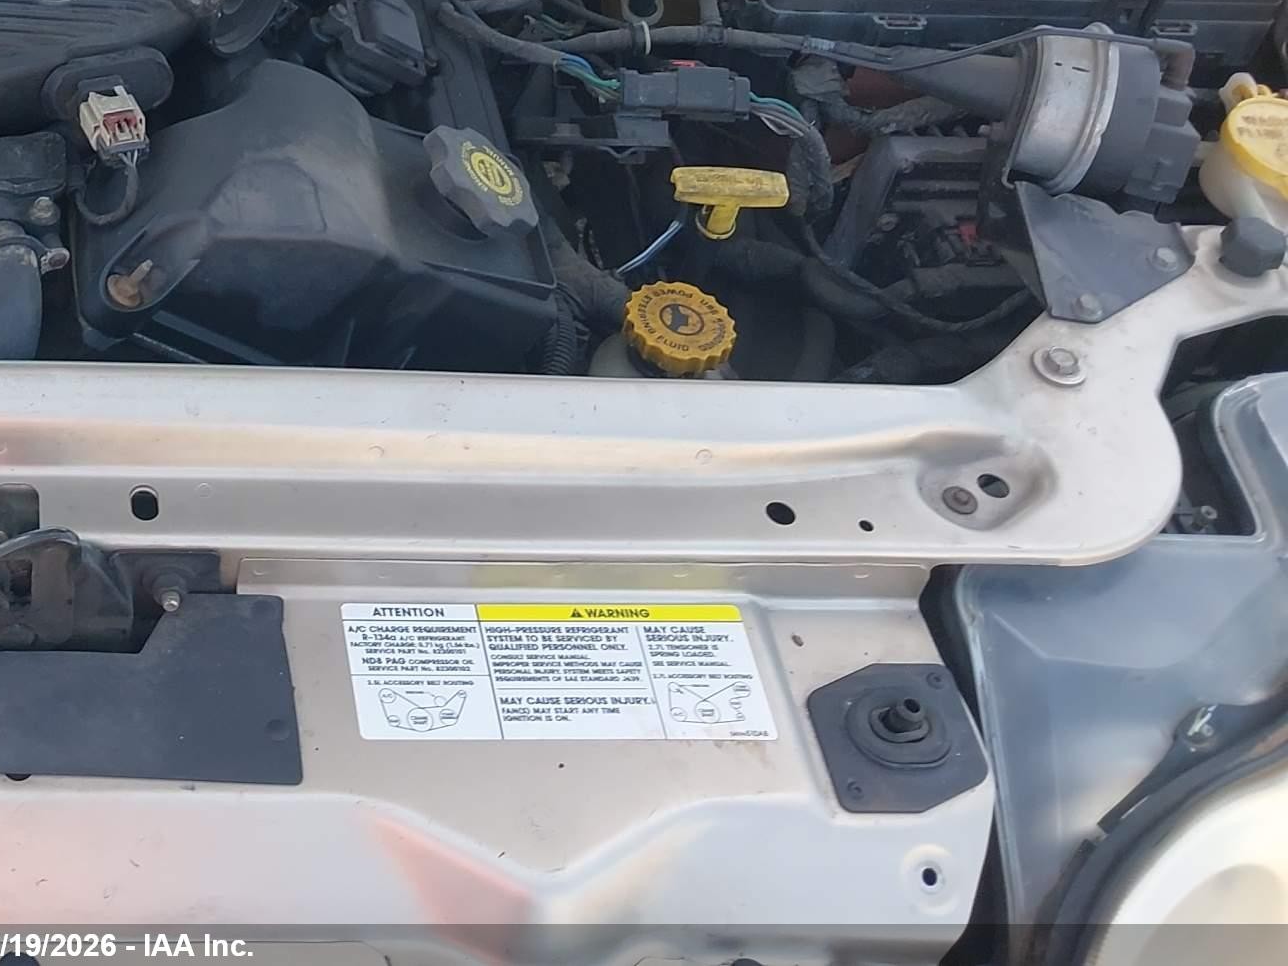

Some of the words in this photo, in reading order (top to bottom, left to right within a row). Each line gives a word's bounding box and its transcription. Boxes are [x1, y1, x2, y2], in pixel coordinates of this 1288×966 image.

[654, 289, 693, 299] POWER
[656, 334, 689, 352] FLUID
[372, 607, 445, 617] ATTENTION
[584, 608, 650, 618] WARNING
[348, 626, 367, 634] A/C
[369, 626, 410, 634] CHARGE
[412, 626, 477, 634] REQUIREMENT
[485, 626, 562, 634] HIGH-PRESSURE
[565, 626, 629, 634] REFRIGERANT
[643, 626, 667, 634] MAY
[670, 626, 706, 634] CAUSE
[646, 634, 690, 642] SERIOUS
[500, 697, 522, 705] MAY
[526, 697, 560, 705] CAUSE
[564, 697, 608, 705] SERIOUS
